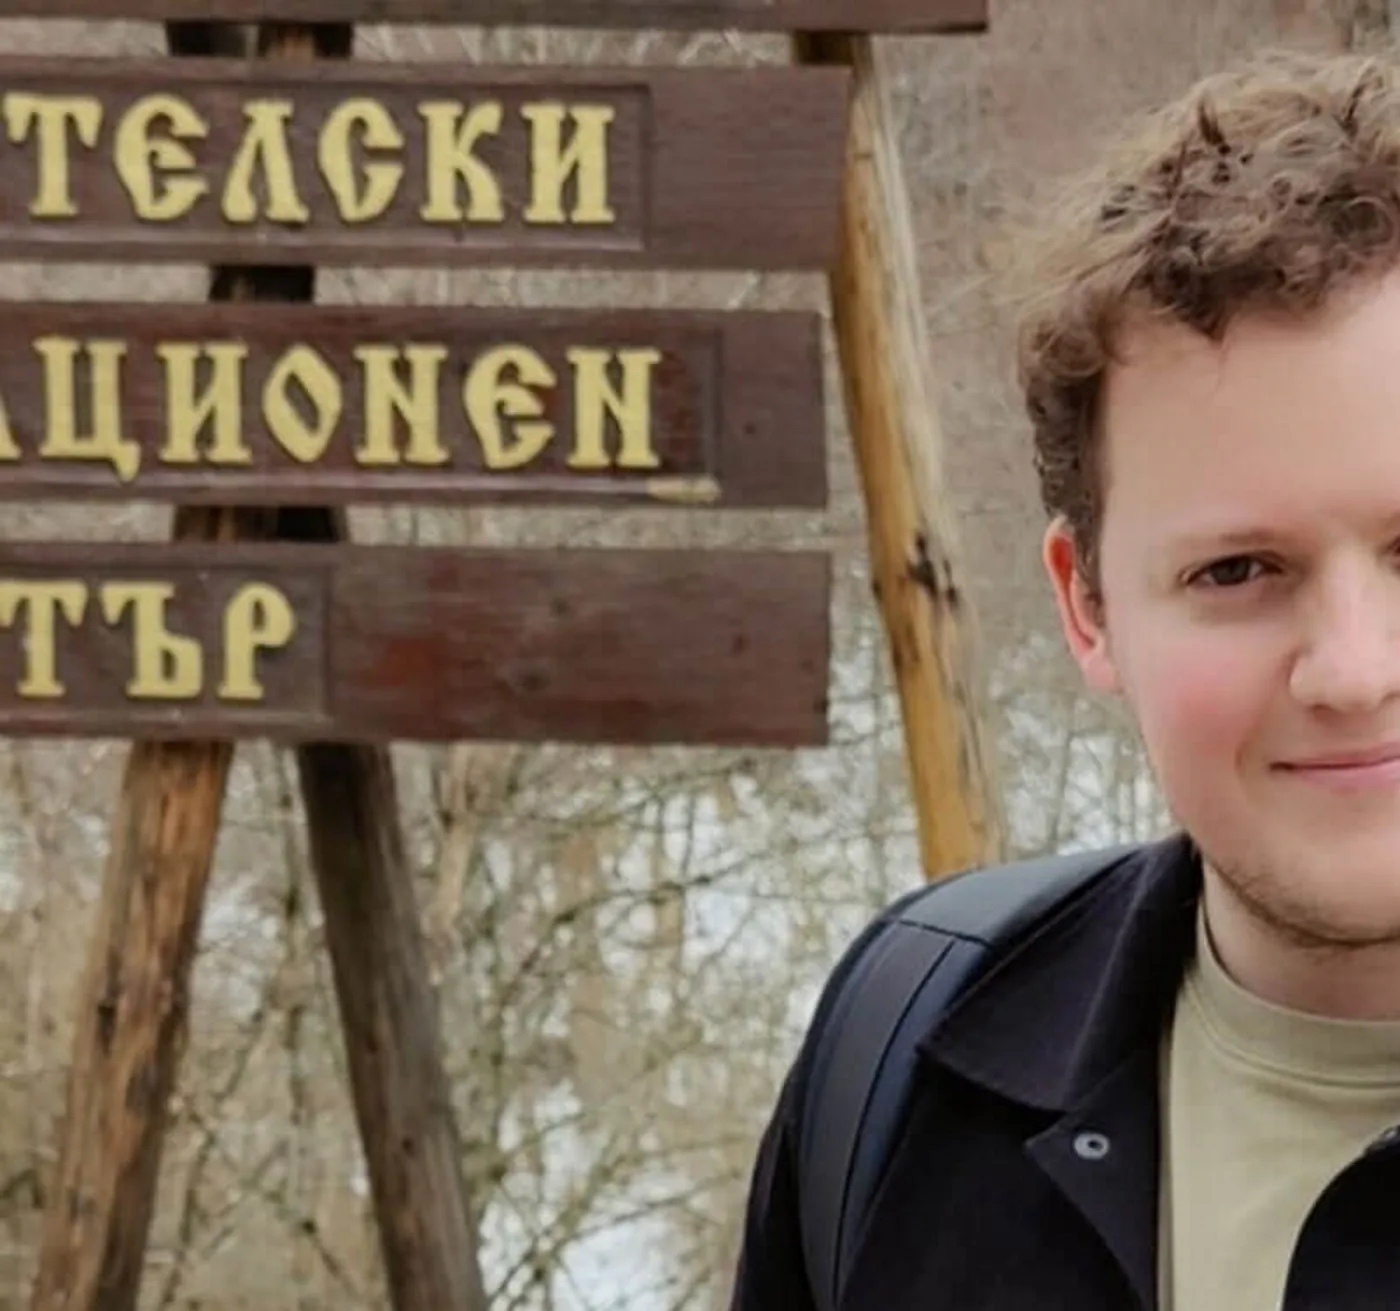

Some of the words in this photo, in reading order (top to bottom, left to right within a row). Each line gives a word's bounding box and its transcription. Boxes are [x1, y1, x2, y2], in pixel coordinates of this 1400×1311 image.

[2, 90, 615, 224] ТЕЛСКИ
[0, 335, 661, 483] ЦИОНЕН
[0, 579, 296, 699] ТЪР
